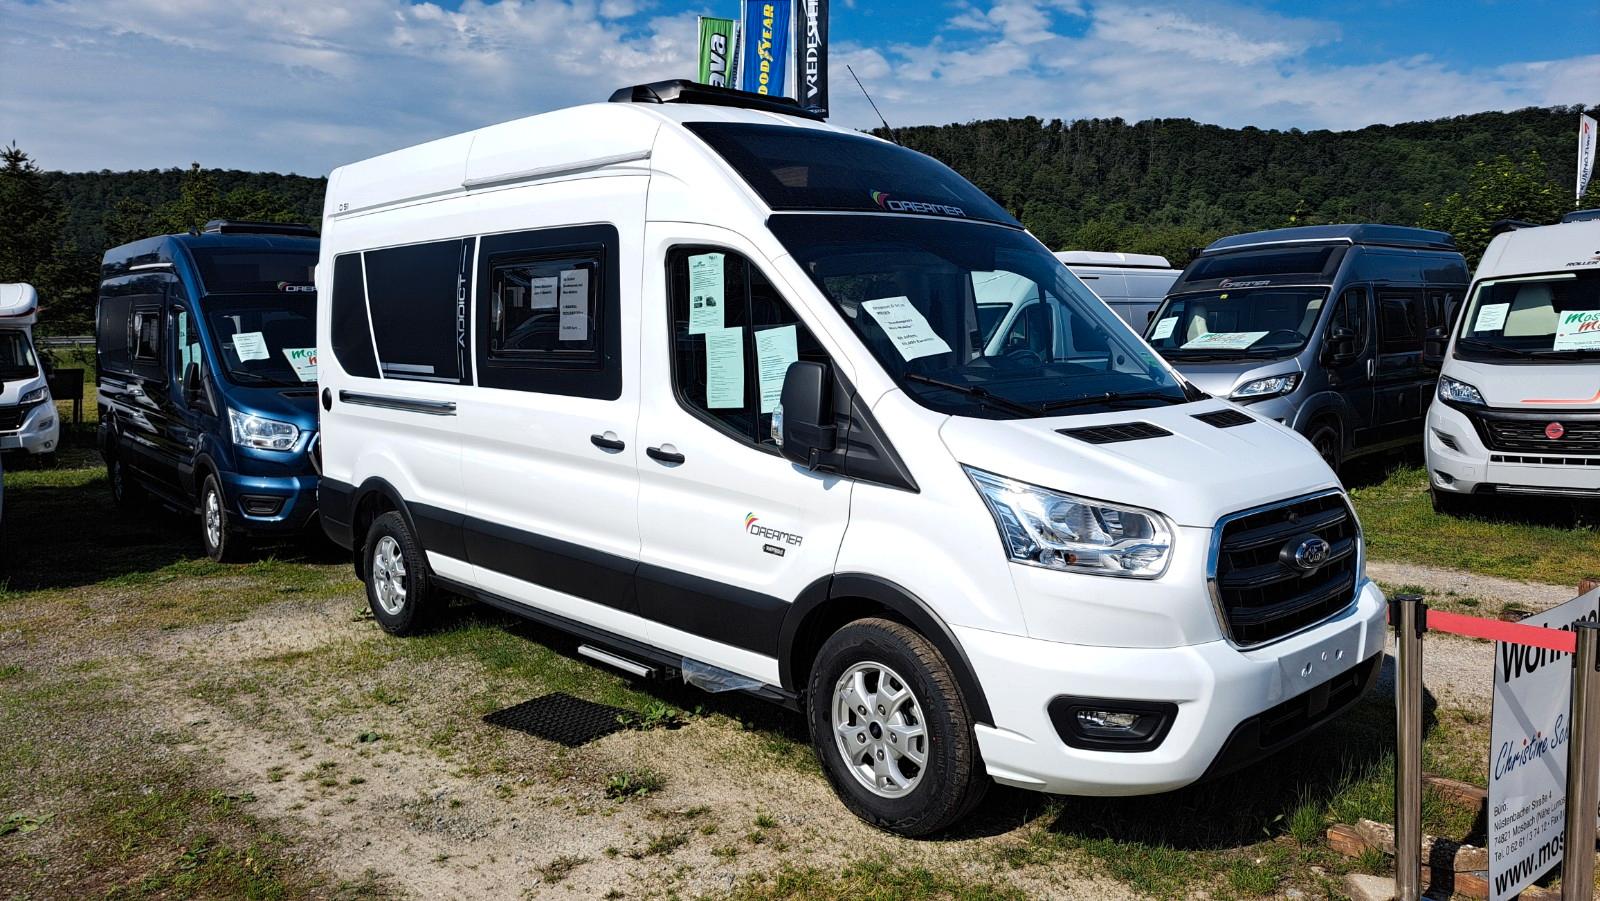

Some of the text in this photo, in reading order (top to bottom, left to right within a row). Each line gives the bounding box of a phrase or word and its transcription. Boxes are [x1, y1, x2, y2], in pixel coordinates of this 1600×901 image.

[709, 33, 727, 88] ava
[757, 4, 775, 95] OODYEAR
[887, 200, 966, 217] DREAMER
[458, 274, 467, 348] ADDICT
[750, 524, 804, 547] DREAMER
[1495, 731, 1549, 781] Christine
[1494, 830, 1511, 847] 74821
[1512, 816, 1536, 837] Mosbach
